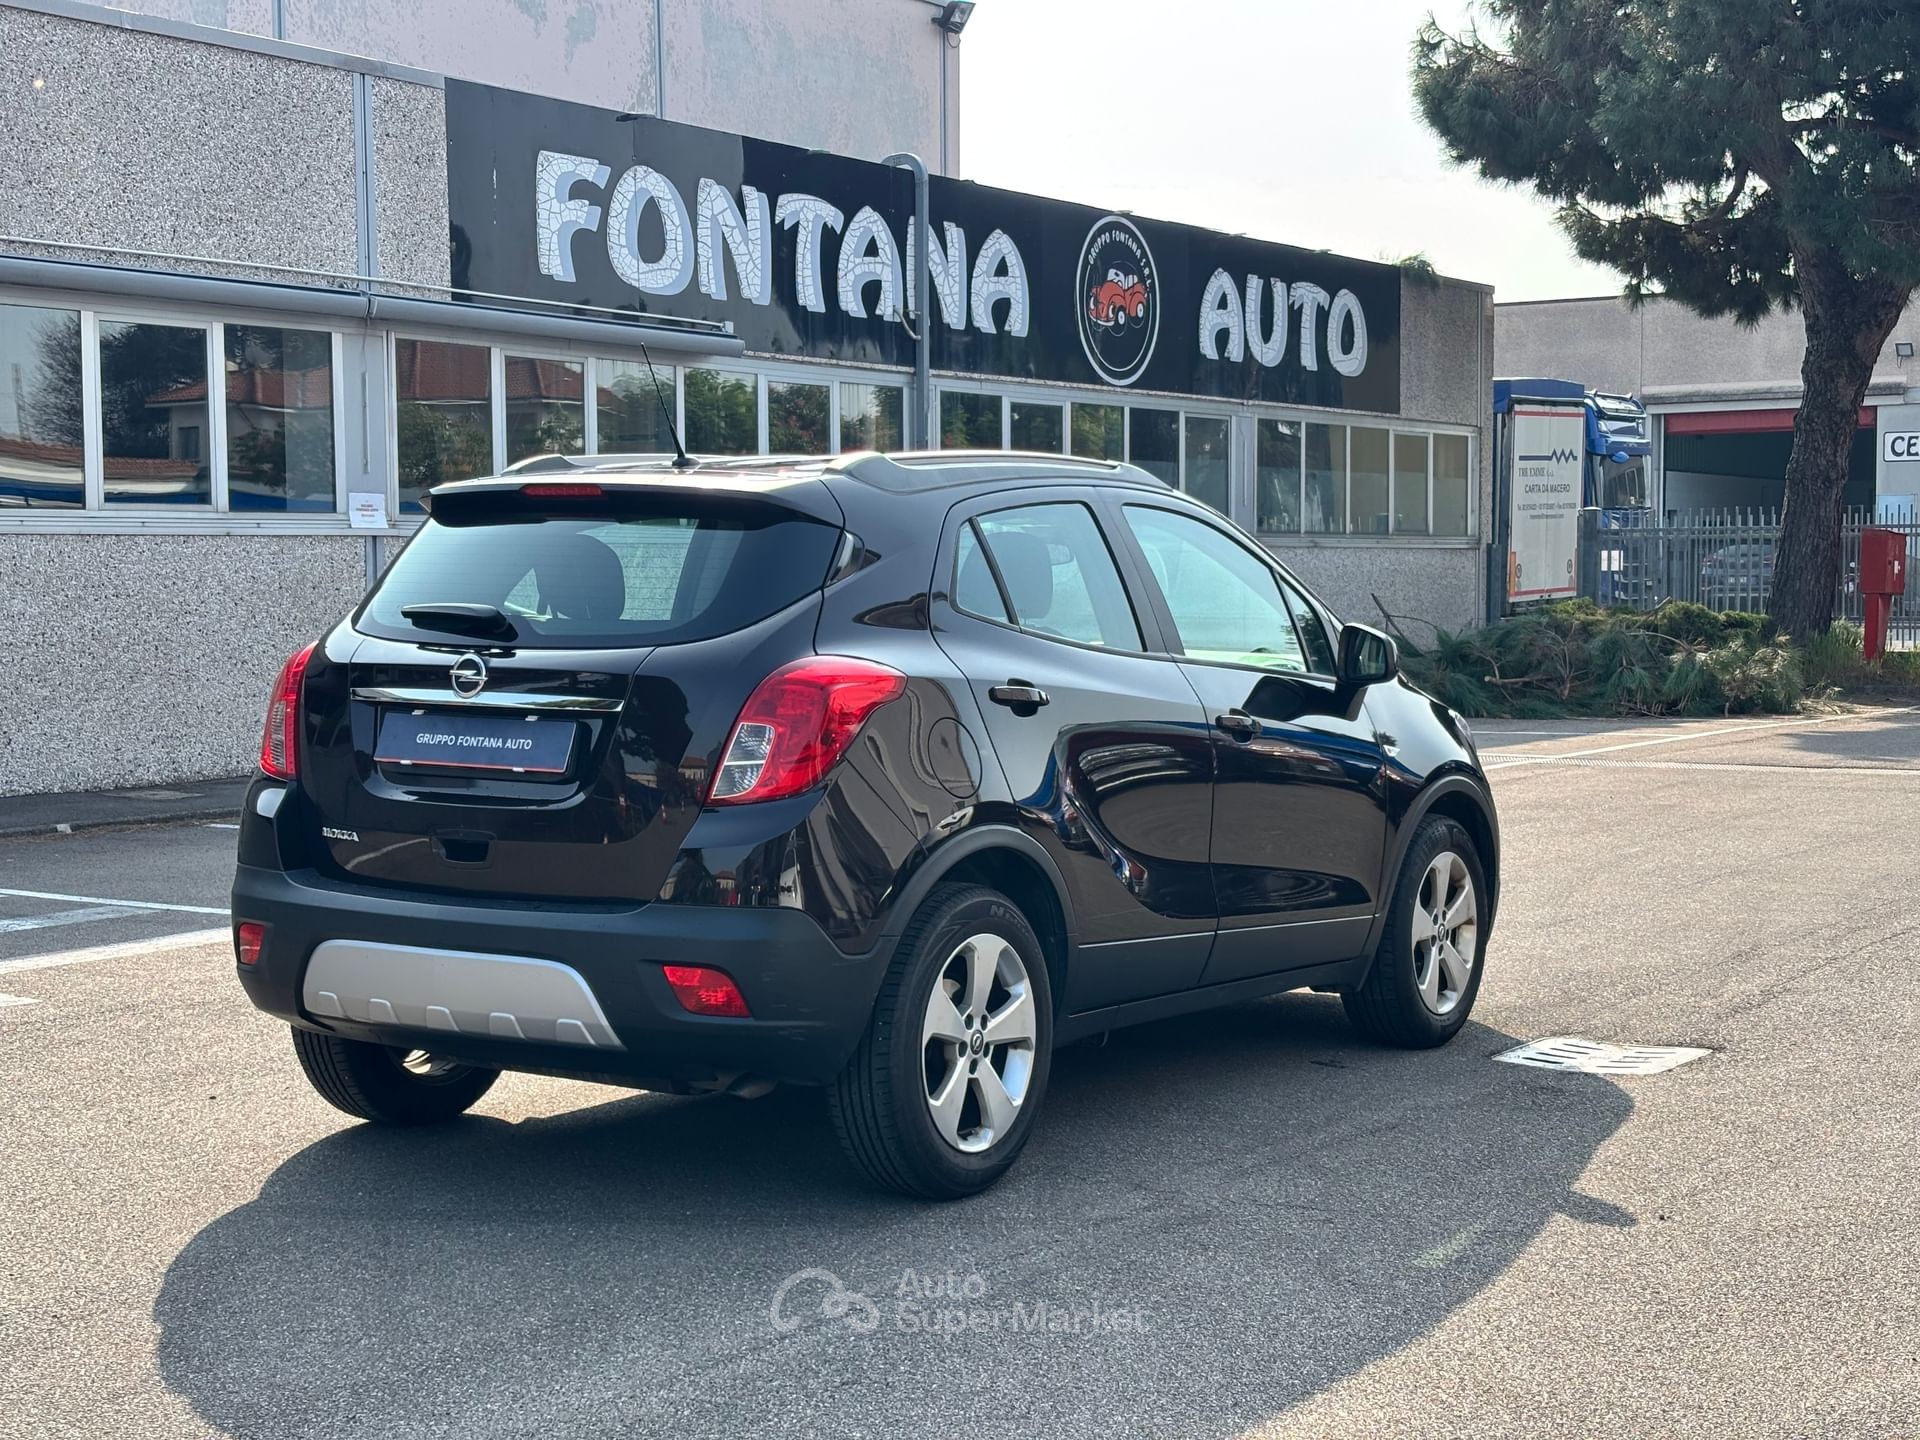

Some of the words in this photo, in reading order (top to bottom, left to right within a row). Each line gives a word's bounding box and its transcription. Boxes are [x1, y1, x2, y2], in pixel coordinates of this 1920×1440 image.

[536, 150, 1029, 337] FONTANA
[1199, 267, 1368, 377] AUTO
[1088, 231, 1110, 265] GRUPPO
[1112, 229, 1141, 259] FONTANA
[416, 733, 455, 745] GRUPPO
[457, 736, 502, 748] FONTANA
[504, 738, 532, 749] AUTO
